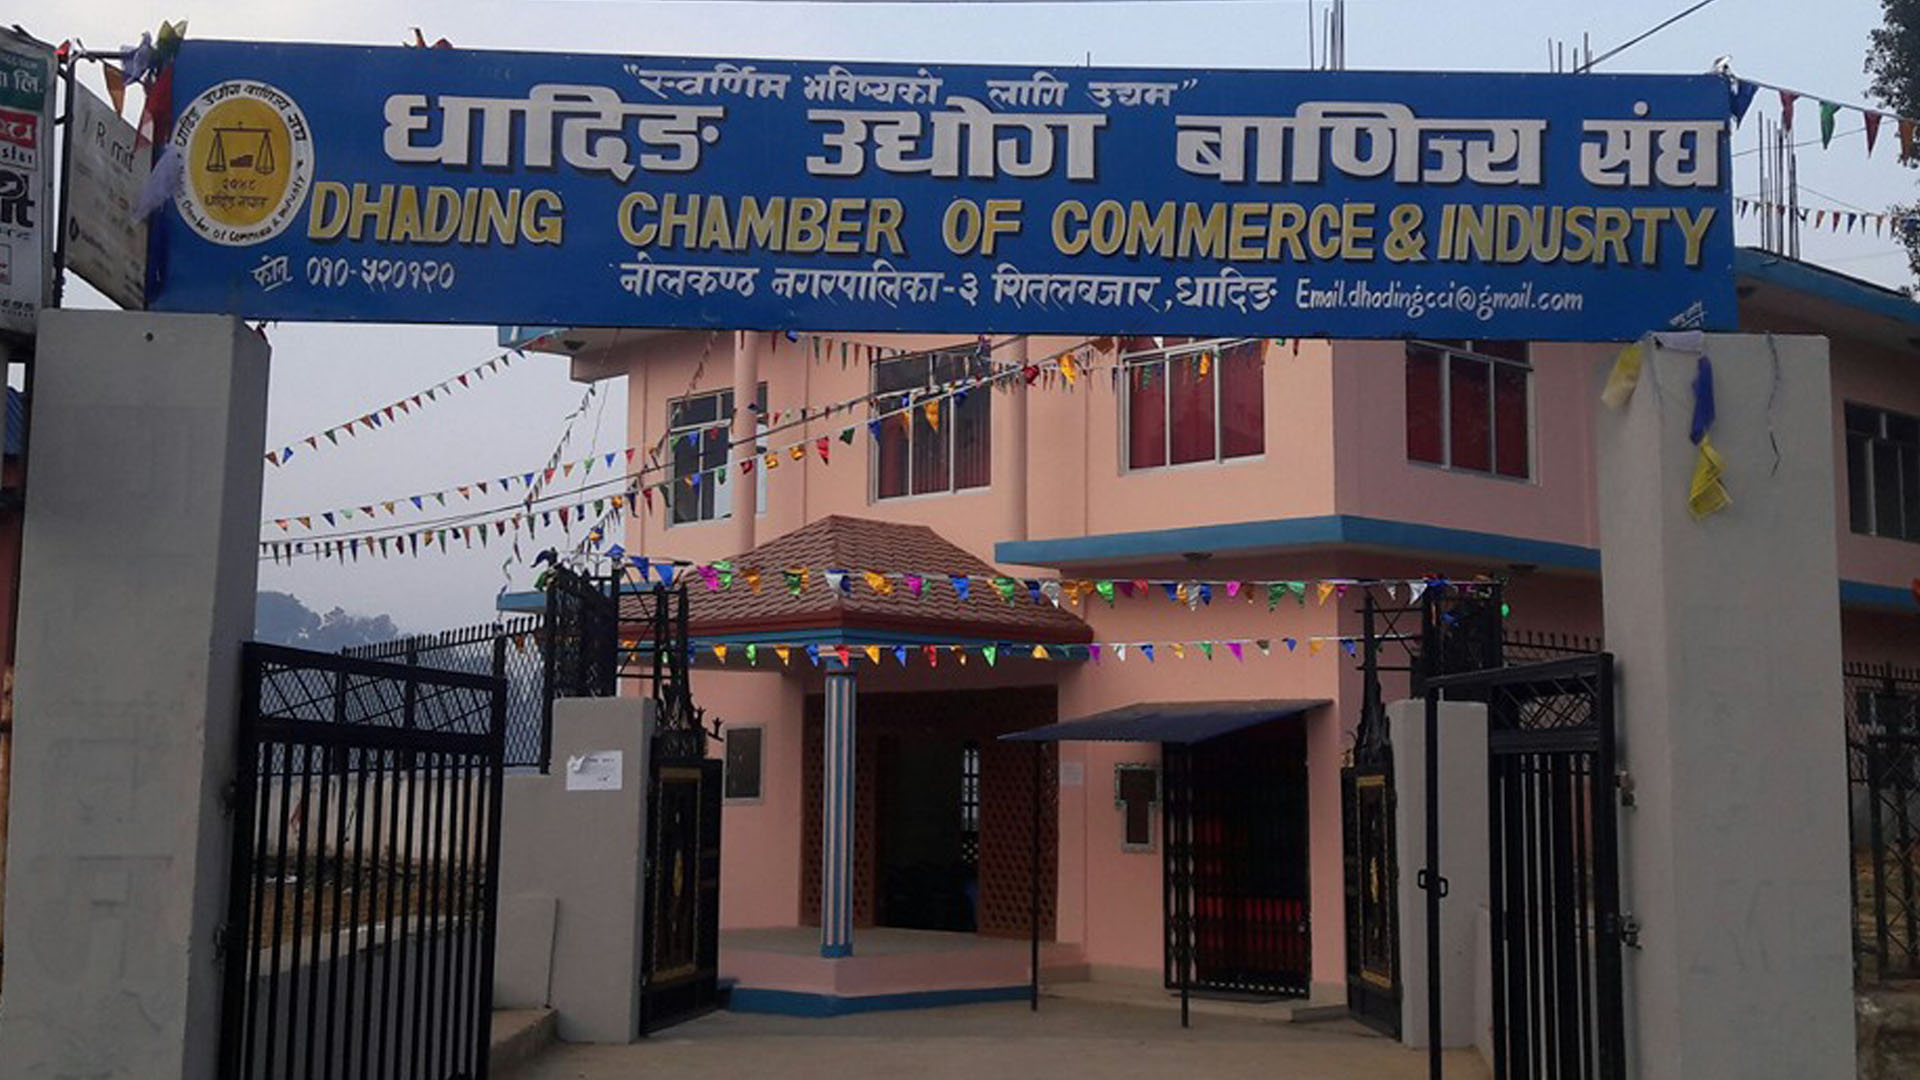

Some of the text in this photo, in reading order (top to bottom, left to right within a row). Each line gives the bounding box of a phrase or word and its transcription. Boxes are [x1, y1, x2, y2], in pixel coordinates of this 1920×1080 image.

[803, 65, 943, 105] भविष्यको
[986, 71, 1069, 110] लागि
[383, 84, 1725, 187] धादिङ उद्योग बाणिज्य संघ
[307, 181, 1716, 265] DHADING CHAMBER OF COMMERCE & INDUSRTY
[619, 251, 760, 298] नीलकण्ठ
